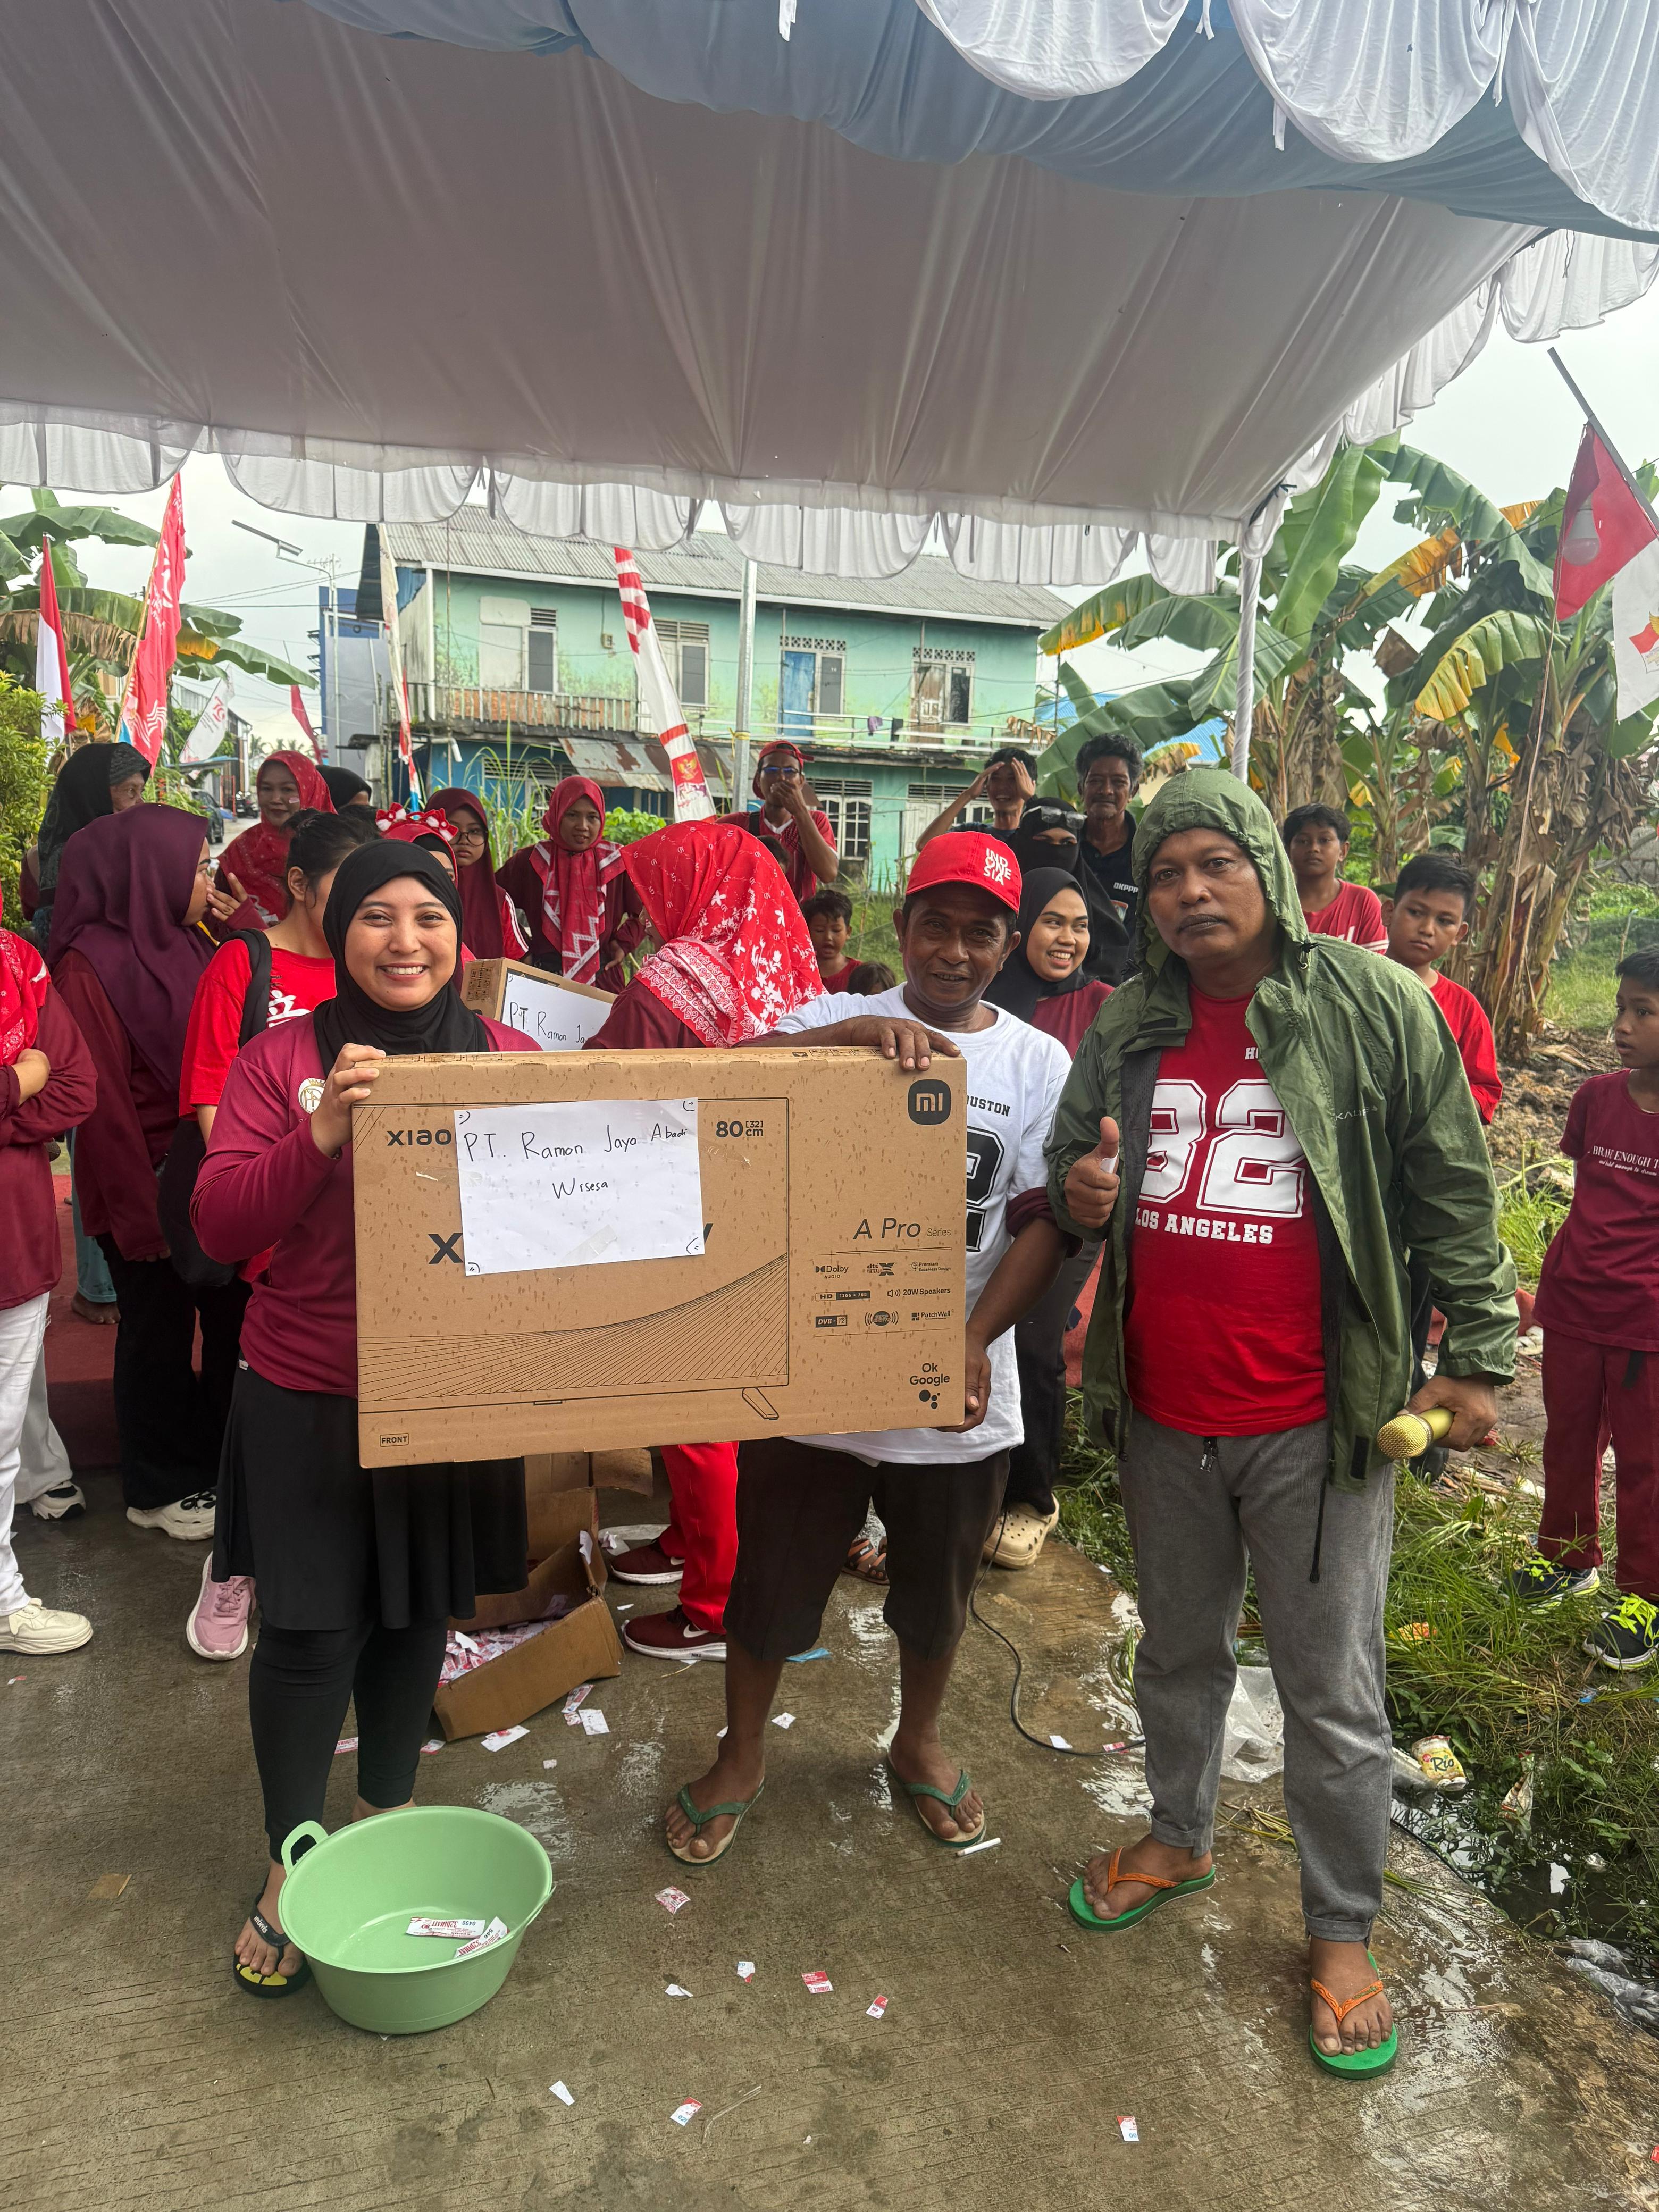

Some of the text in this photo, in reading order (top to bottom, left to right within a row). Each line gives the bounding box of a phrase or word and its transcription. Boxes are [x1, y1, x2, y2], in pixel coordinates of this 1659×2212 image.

[983, 866, 1004, 886] SIA
[537, 1011, 567, 1041] Ramon
[716, 1121, 743, 1138] 80
[745, 1128, 764, 1137] cm
[464, 1133, 506, 1162] PT.
[521, 1132, 583, 1160] Ramon
[651, 1122, 688, 1142] Abadi
[1614, 1150, 1652, 1168] ENOUGH
[1653, 1159, 1659, 1169] T
[552, 1177, 608, 1199] Wisesa
[852, 1218, 951, 1240] A Pro Series
[1135, 1207, 1274, 1245] LOS ANGELES
[826, 1265, 849, 1273] Dolby
[919, 1287, 951, 1296] Speakers
[922, 1363, 938, 1373] Ok
[910, 1373, 950, 1386] Google
[1430, 1754, 1455, 1772] Rio
